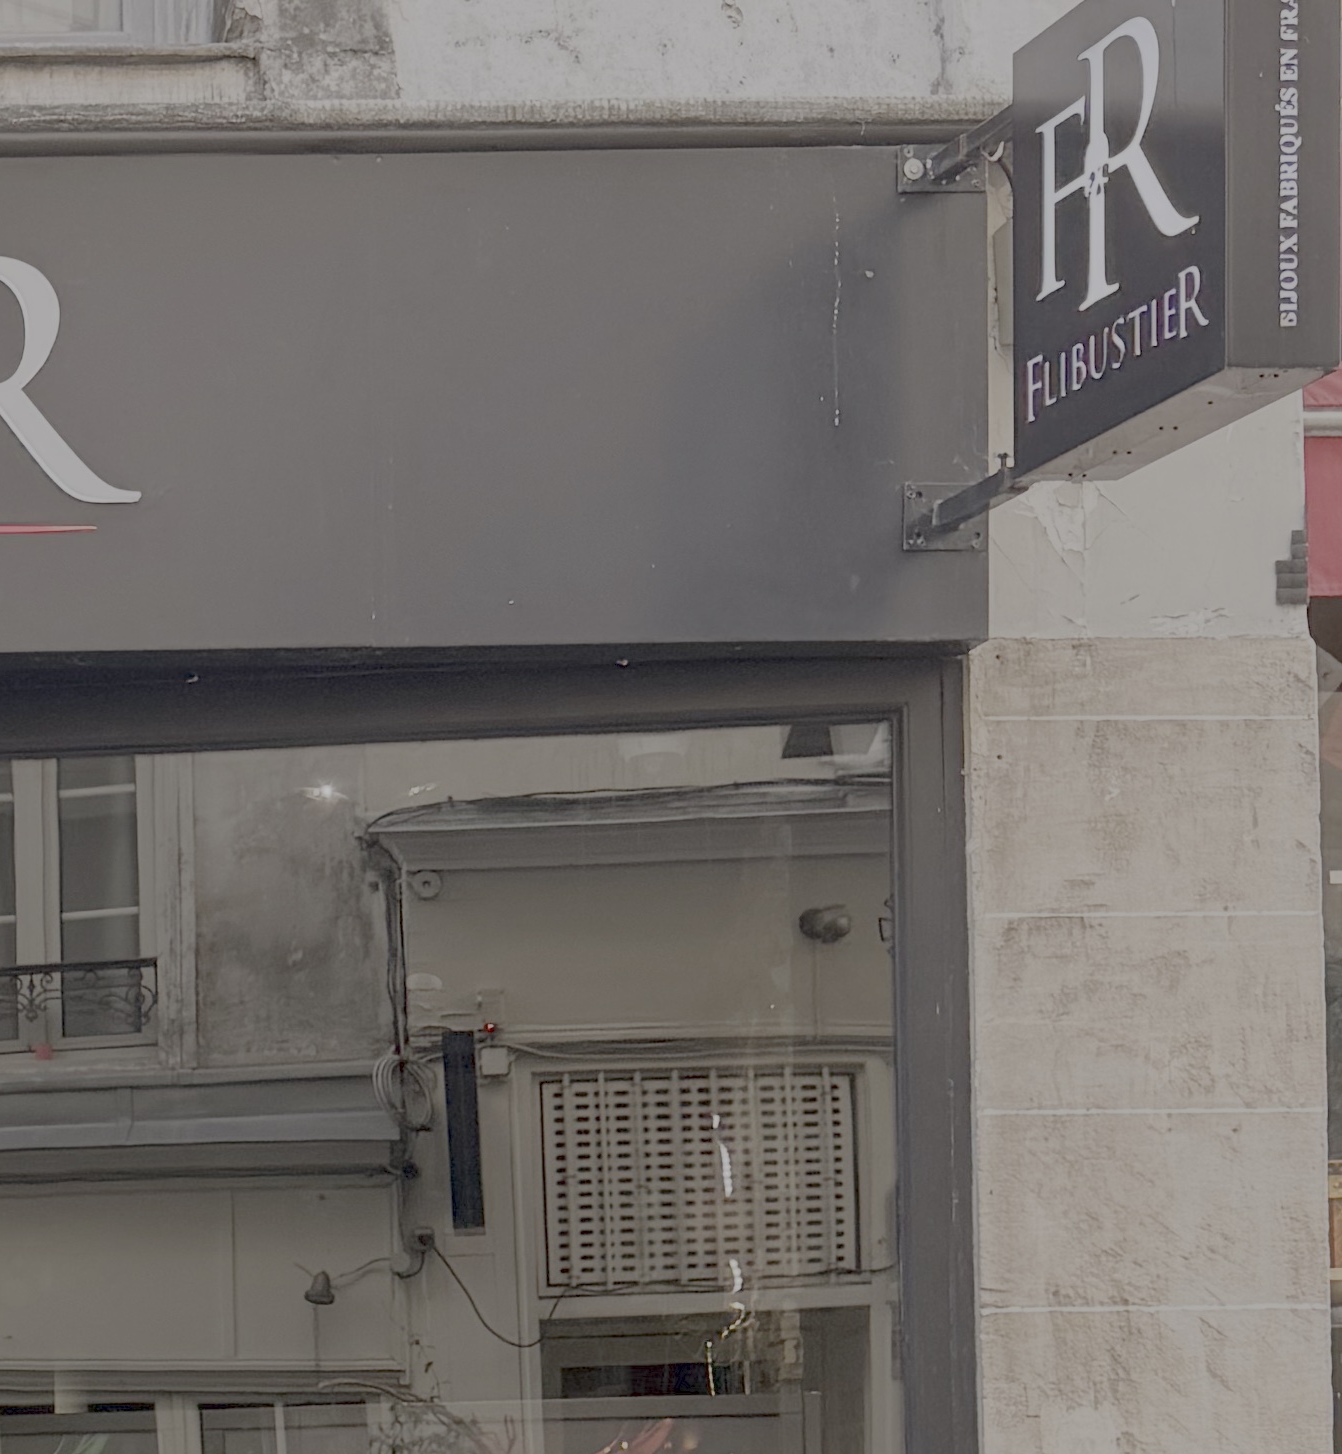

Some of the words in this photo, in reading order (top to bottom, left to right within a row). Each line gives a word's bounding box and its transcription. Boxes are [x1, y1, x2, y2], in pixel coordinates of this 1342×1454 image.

[1279, 48, 1299, 82] EN
[1274, 87, 1302, 229] FABRIQUÉS
[1279, 233, 1299, 328] BIJOUX
[1025, 265, 1209, 424] FLIBUSTIER
